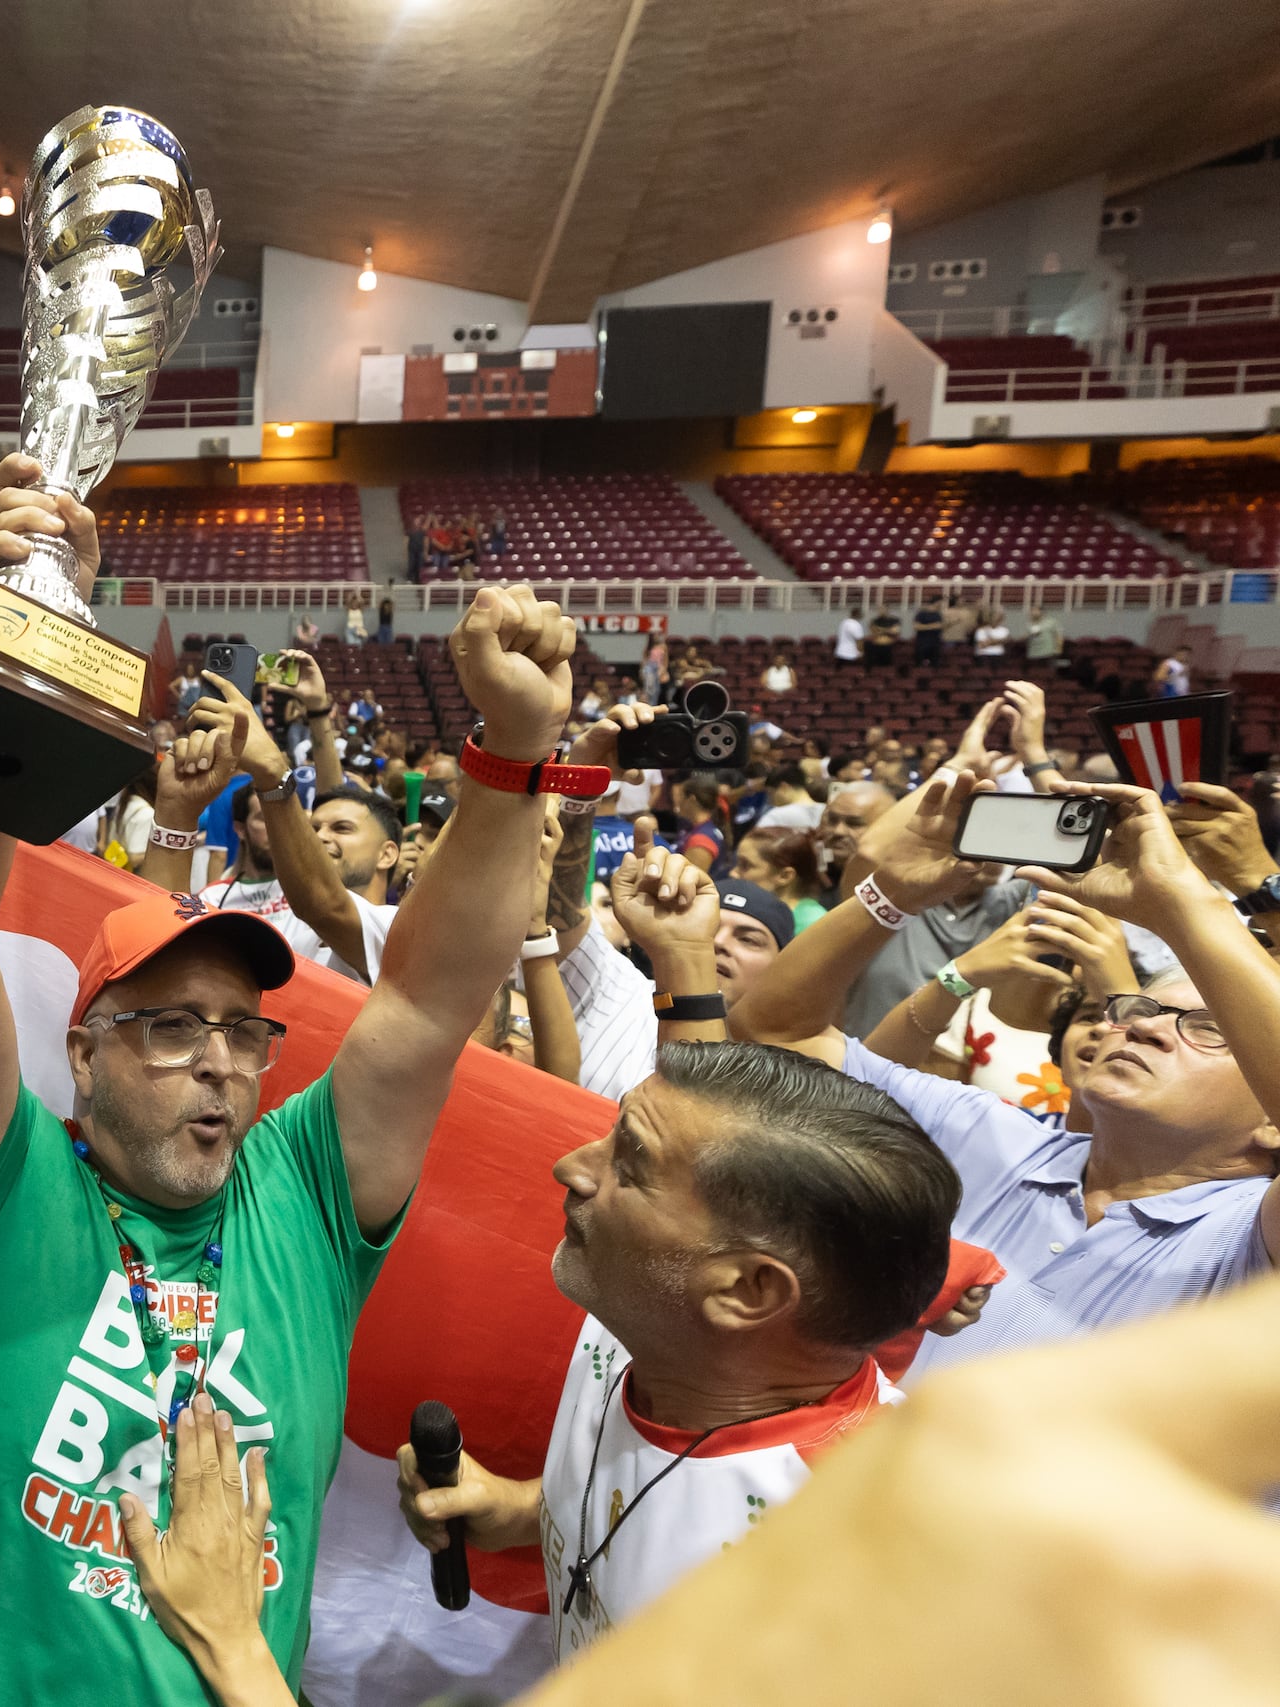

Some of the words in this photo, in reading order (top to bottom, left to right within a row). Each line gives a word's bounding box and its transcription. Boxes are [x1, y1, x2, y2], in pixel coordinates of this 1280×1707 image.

[574, 615, 639, 632] ALCO
[36, 627, 68, 648] Caribes
[69, 643, 80, 655] de
[82, 649, 98, 664] San
[40, 614, 81, 642] Equipo
[85, 637, 138, 671] Campeón
[71, 656, 100, 674] 2024
